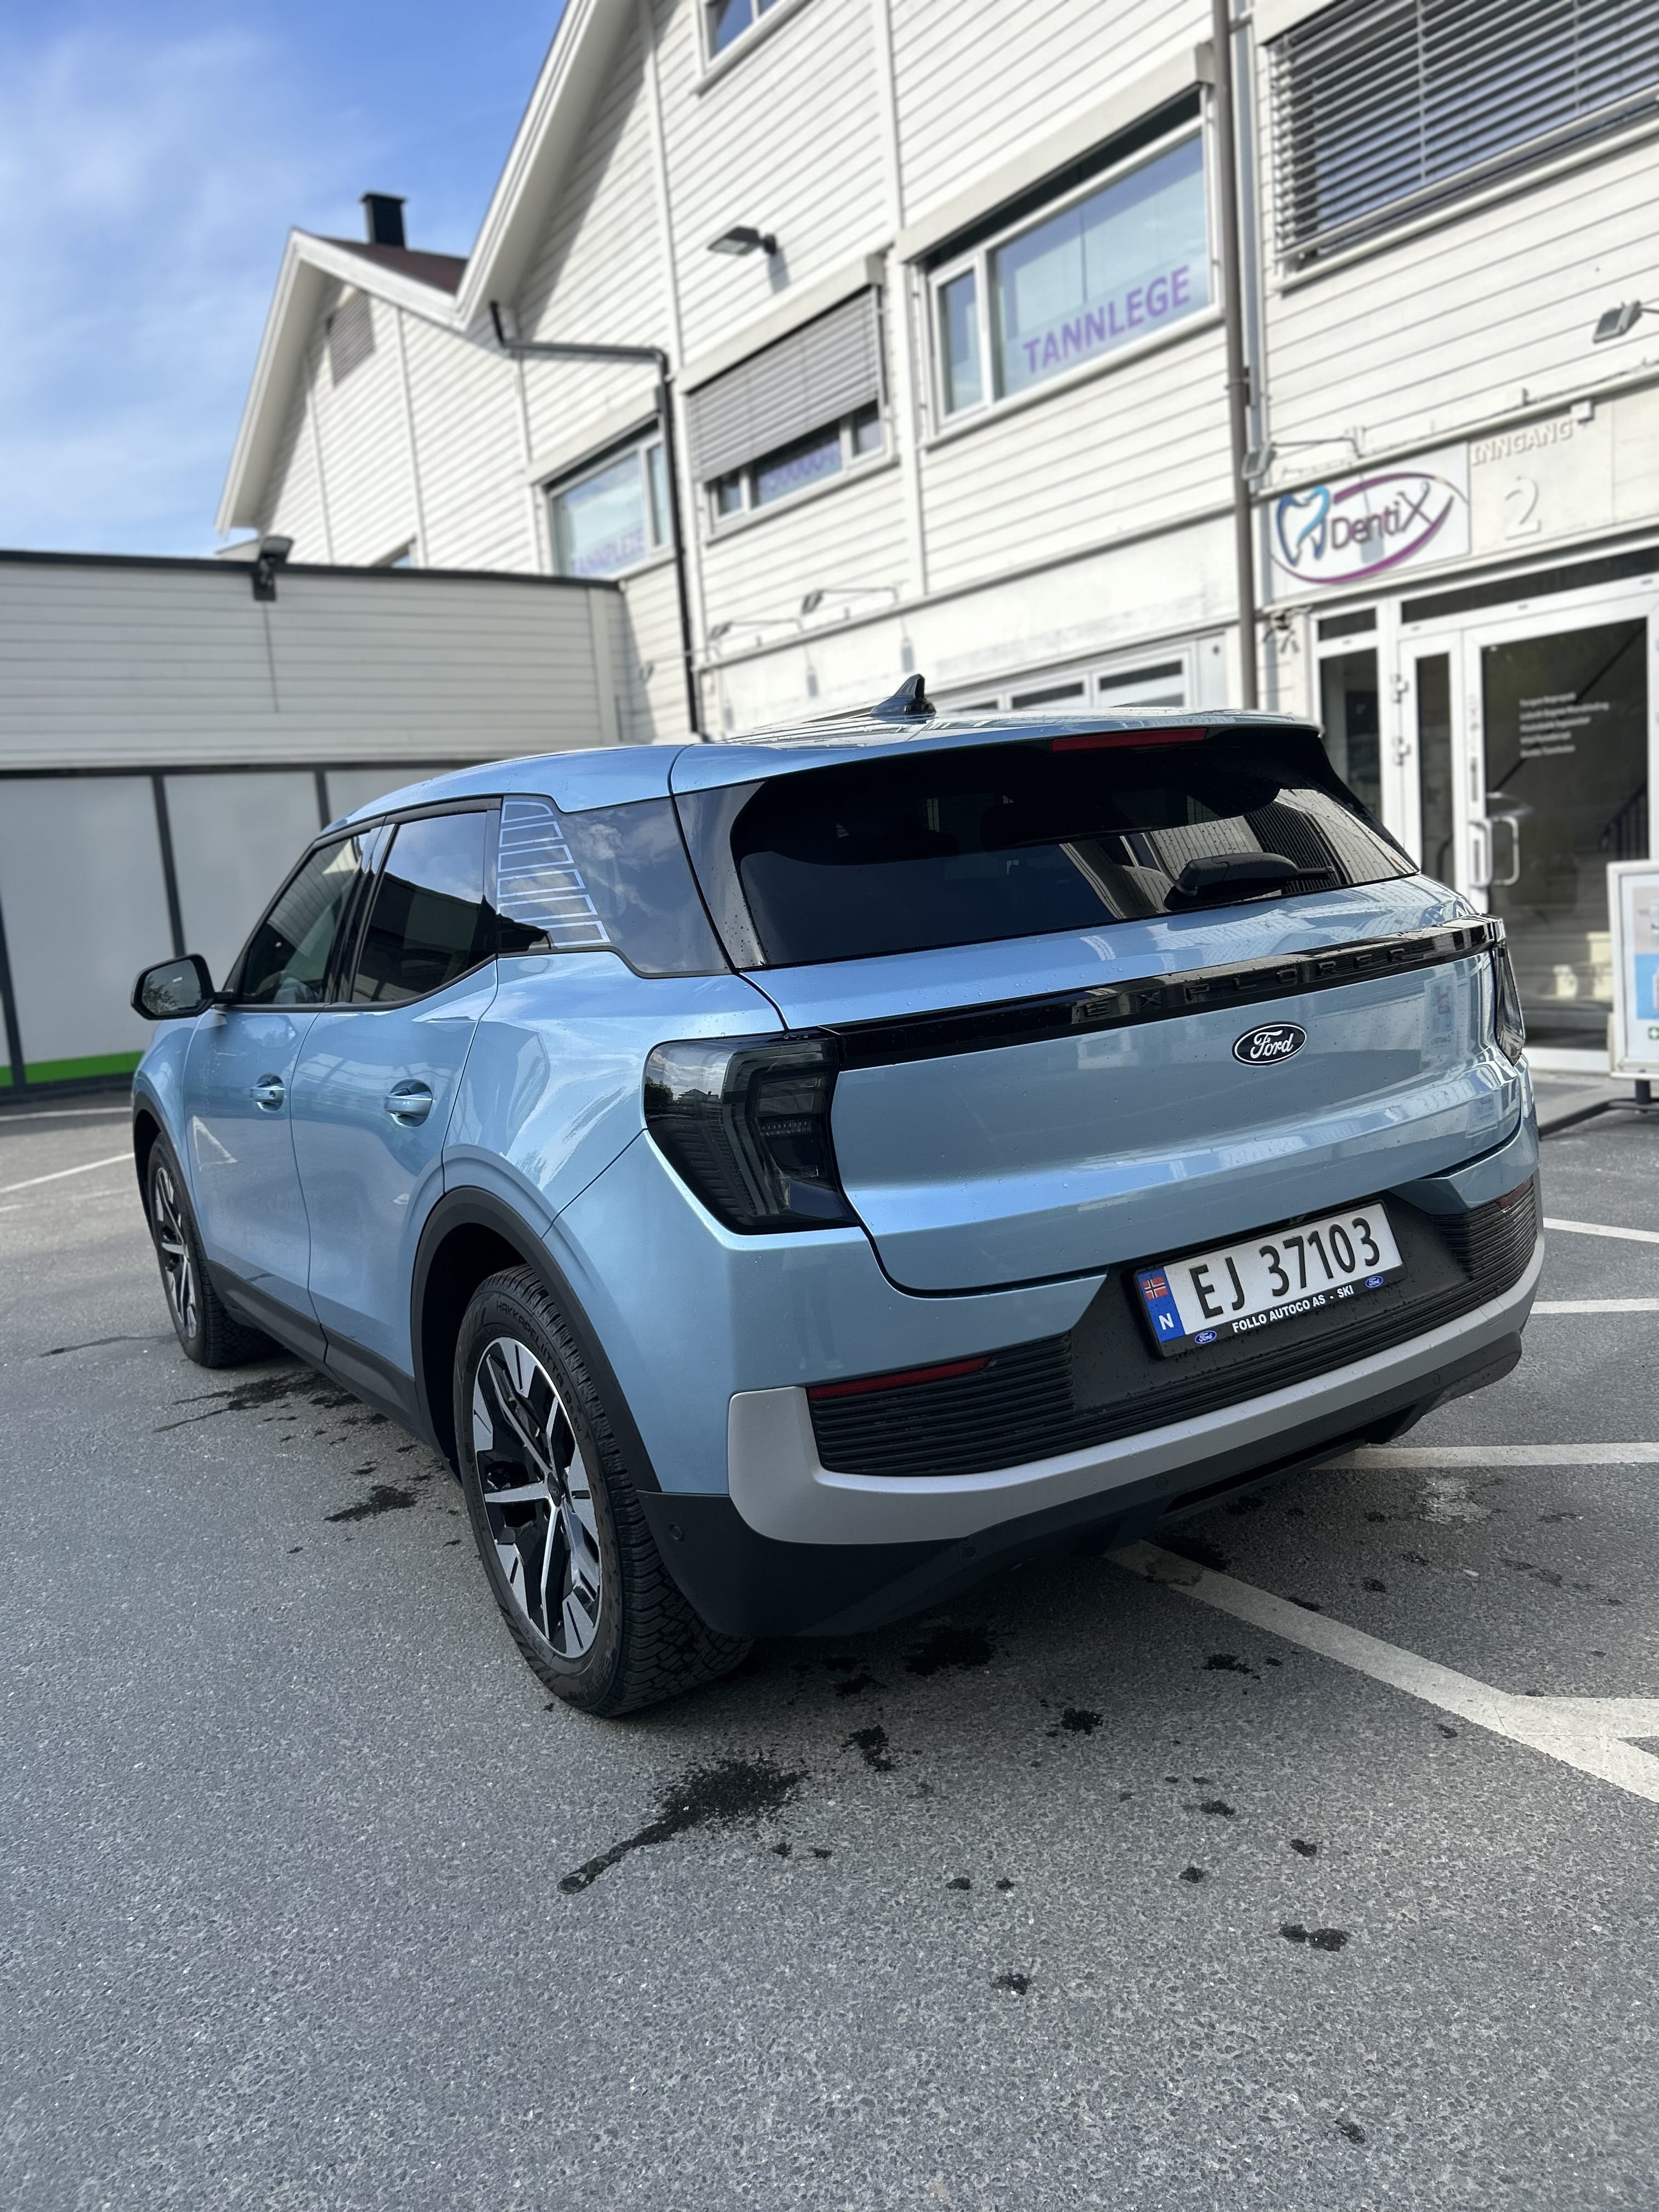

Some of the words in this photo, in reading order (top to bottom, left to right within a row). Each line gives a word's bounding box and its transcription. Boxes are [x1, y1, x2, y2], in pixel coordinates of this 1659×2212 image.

[1023, 264, 1190, 374] TANNLEGE
[1472, 419, 1573, 467] INNGANG
[1331, 481, 1433, 550] DentiX
[1505, 475, 1542, 541] 2
[1083, 947, 1407, 1017] EXPLORER
[1250, 1030, 1295, 1059] Ford
[1188, 1256, 1245, 1319] EJ
[1259, 1217, 1380, 1297] 37103
[1158, 1312, 1175, 1330] N
[1232, 1313, 1267, 1333] FOLLO
[1269, 1299, 1311, 1322] AUTOCO
[1312, 1294, 1327, 1308] AS
[1336, 1284, 1355, 1299] SKI
[496, 1300, 565, 1389] HAKKAPELIITTA
